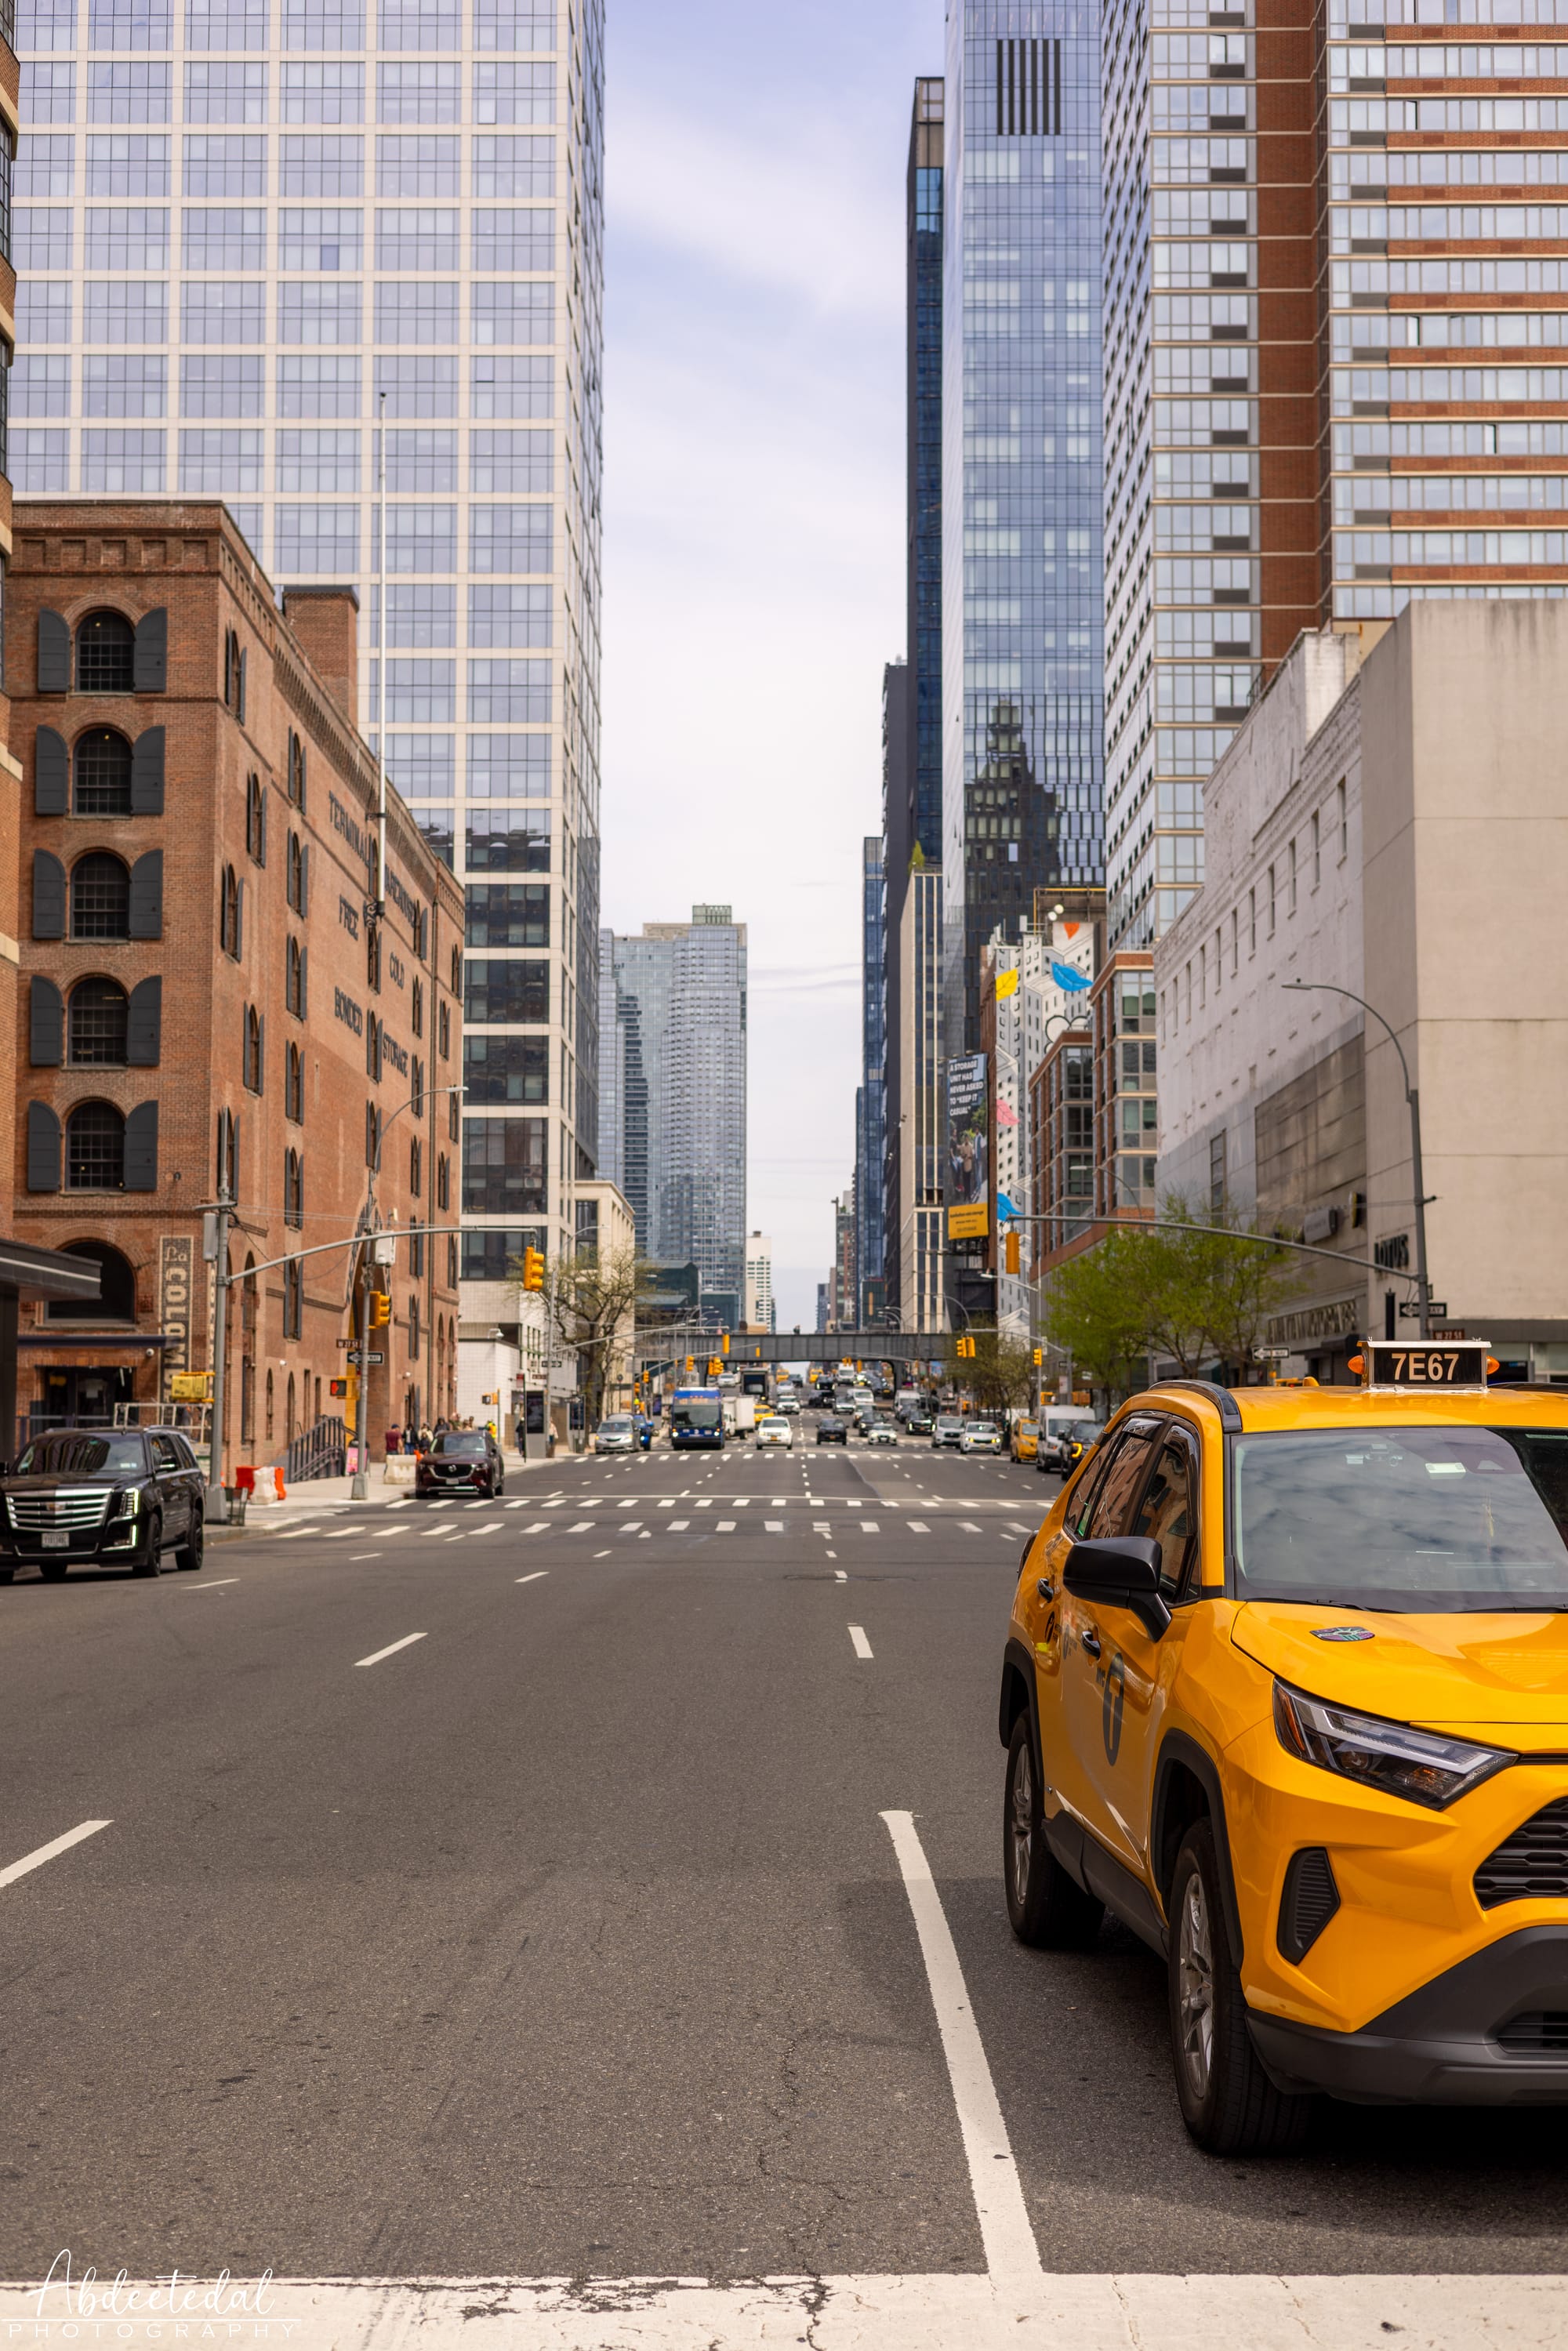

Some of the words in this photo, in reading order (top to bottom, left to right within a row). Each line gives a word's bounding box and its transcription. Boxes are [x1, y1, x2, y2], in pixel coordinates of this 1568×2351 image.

[328, 789, 369, 869] TERMINAL
[339, 894, 358, 941] FREE
[390, 952, 405, 990] COLD
[335, 985, 363, 1038] BONDED
[383, 1032, 408, 1078] STORAGE
[949, 1074, 961, 1083] UNIT
[961, 1072, 973, 1081] HAS
[954, 1060, 978, 1072] STORAGE
[949, 1084, 966, 1094] NEVER
[966, 1082, 984, 1091] ASKED
[972, 1093, 978, 1101] IT
[1374, 1234, 1410, 1270] LOTUS
[1391, 1352, 1460, 1381] 7E67
